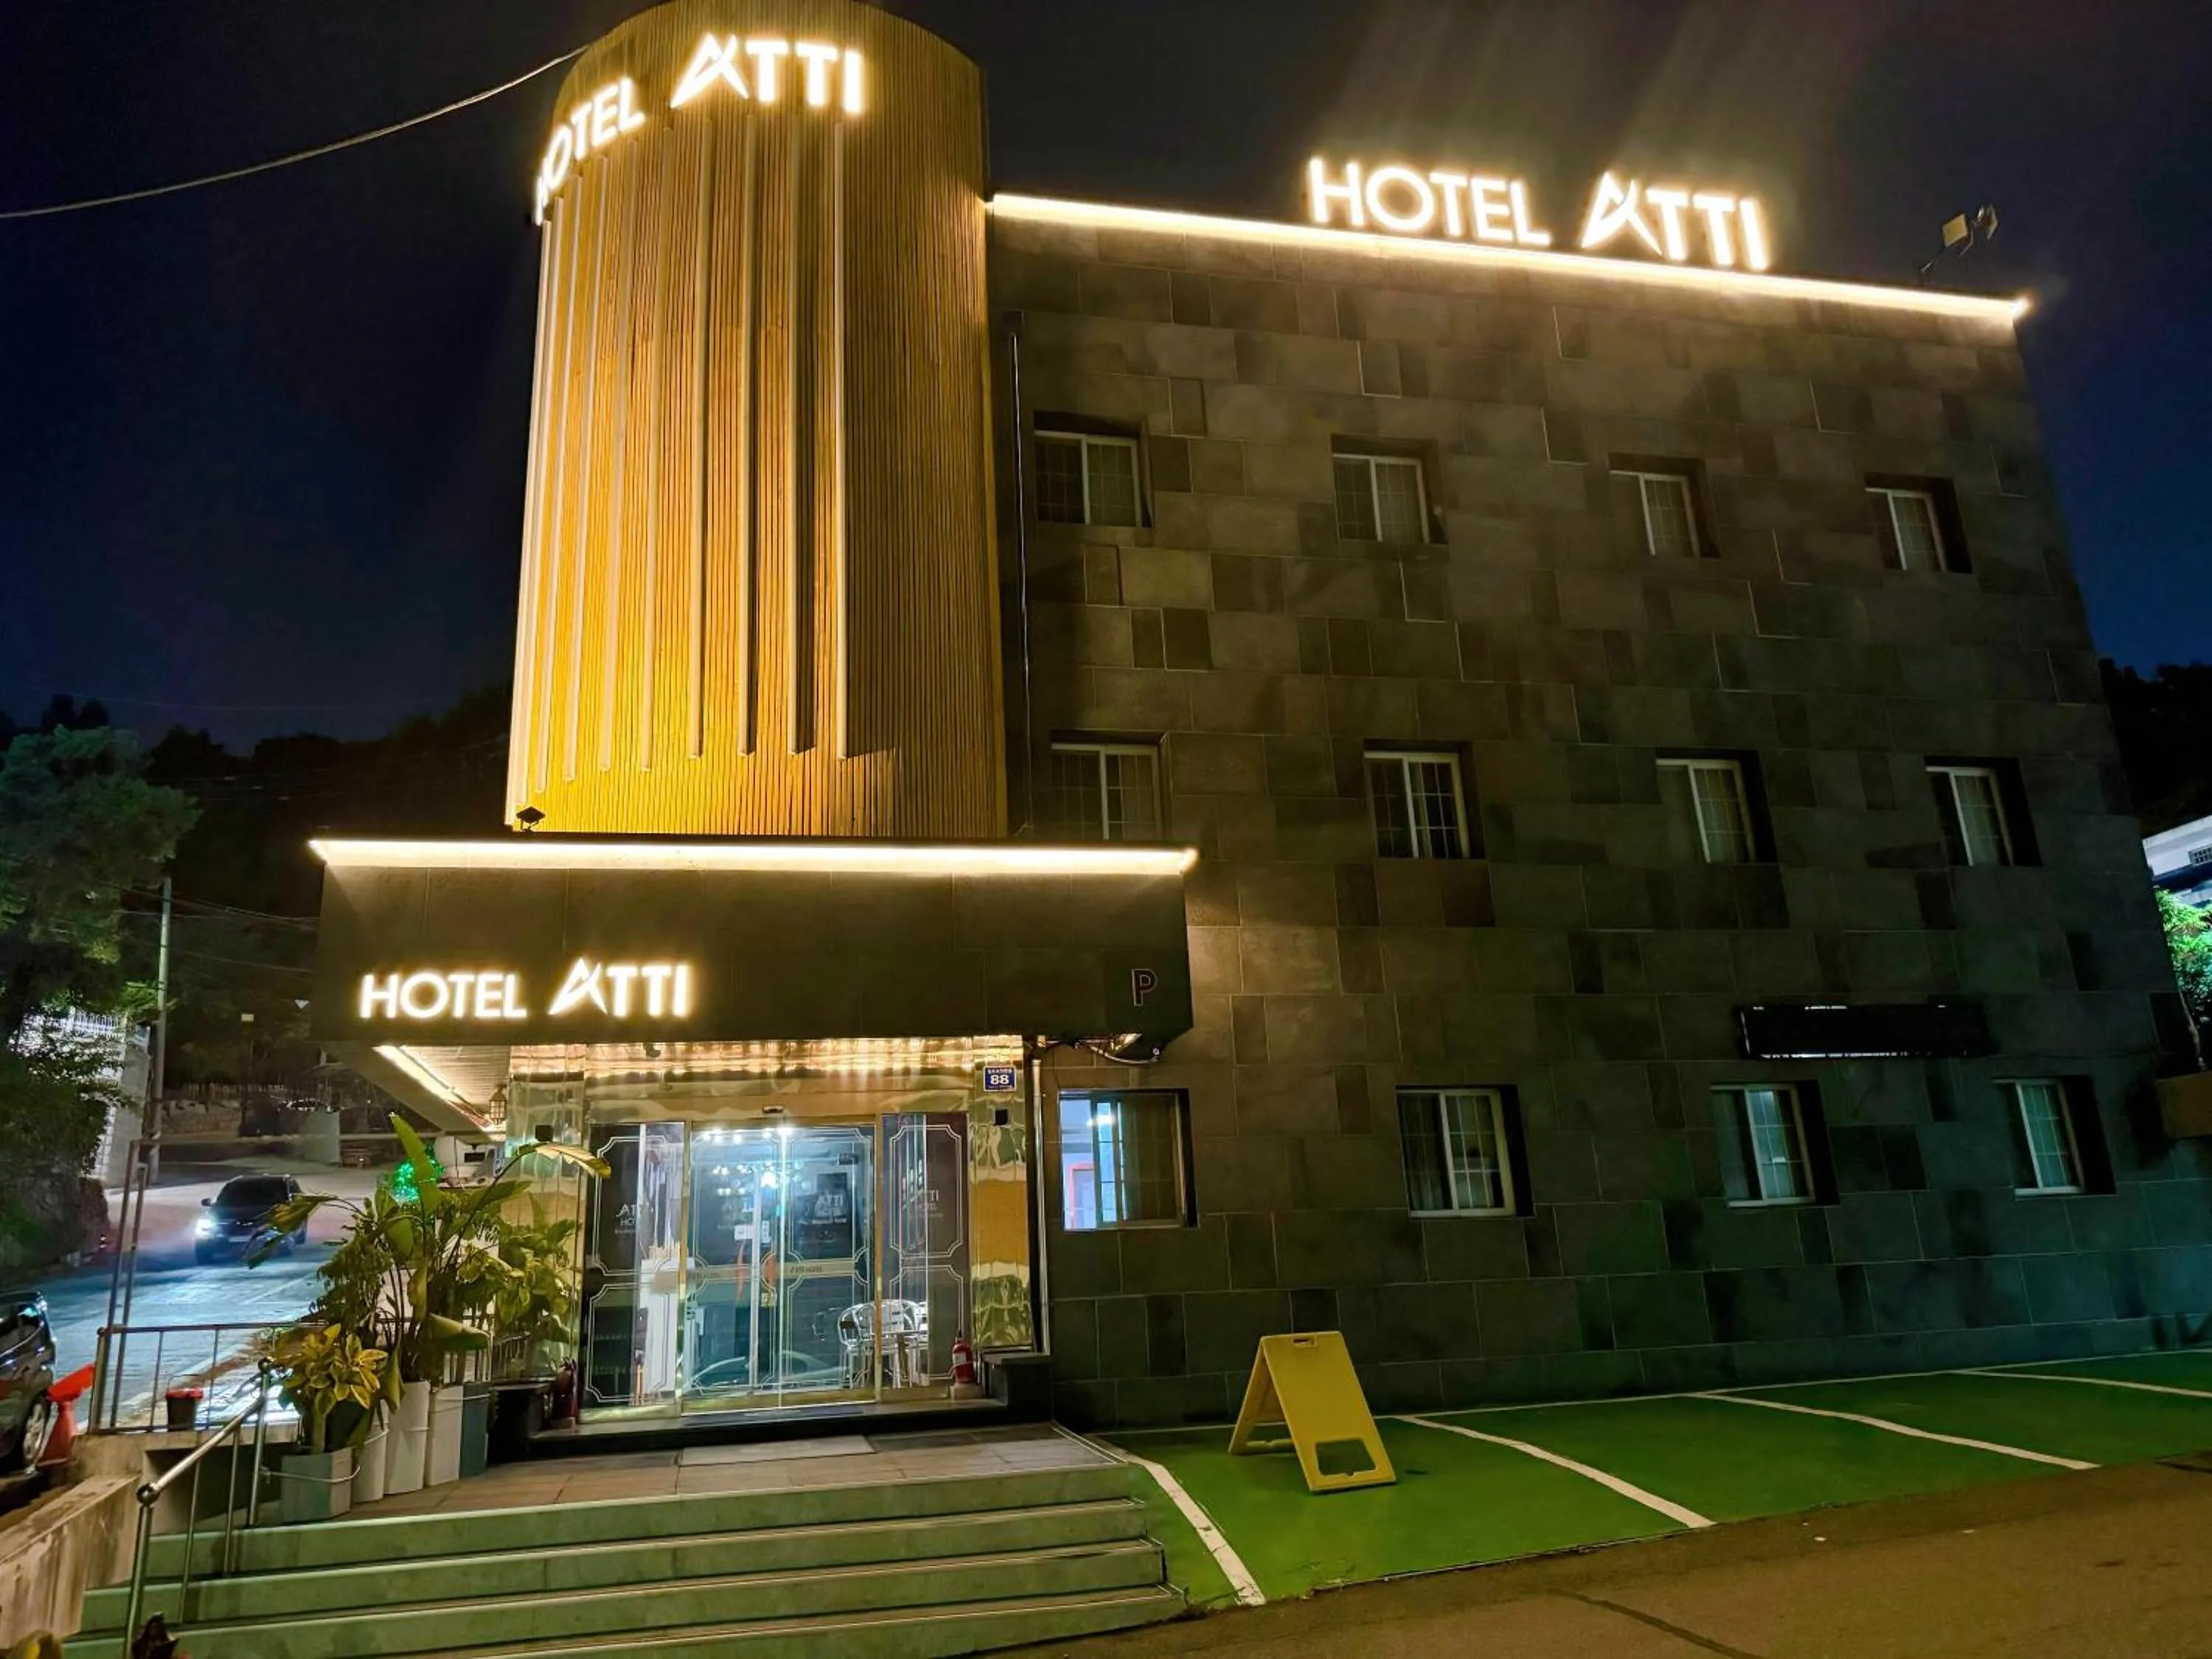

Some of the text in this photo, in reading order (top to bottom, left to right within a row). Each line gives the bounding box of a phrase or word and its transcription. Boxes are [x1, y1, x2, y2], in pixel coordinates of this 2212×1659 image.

[670, 32, 863, 114] ATTI
[1308, 157, 1768, 271] HOTEL ATTI
[360, 958, 689, 1019] HOTEL ATTI
[1131, 968, 1158, 1006] P
[990, 1074, 1009, 1085] 88
